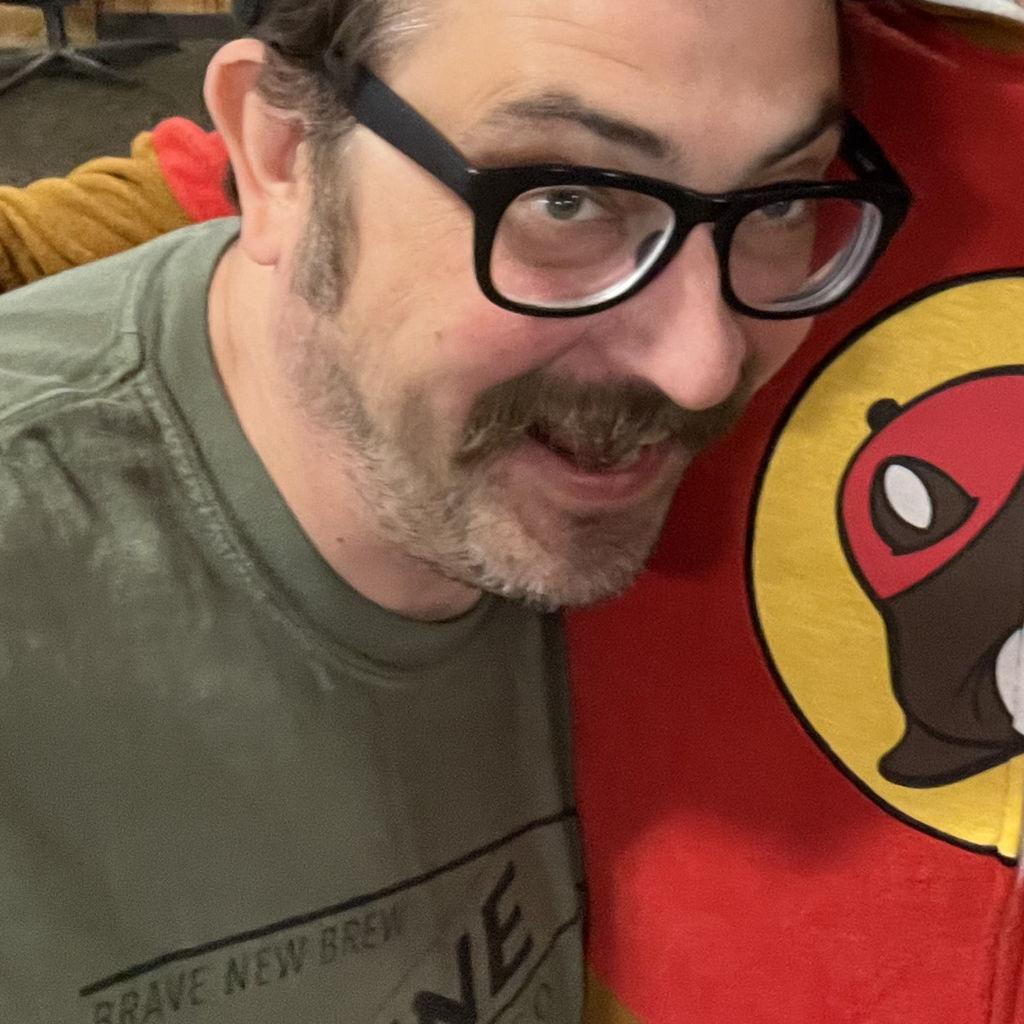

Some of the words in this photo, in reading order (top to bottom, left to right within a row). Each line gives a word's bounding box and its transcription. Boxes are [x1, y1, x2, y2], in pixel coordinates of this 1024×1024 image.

[94, 967, 207, 1024] BRAVE
[223, 937, 309, 996] NEW
[412, 860, 534, 1024] NE
